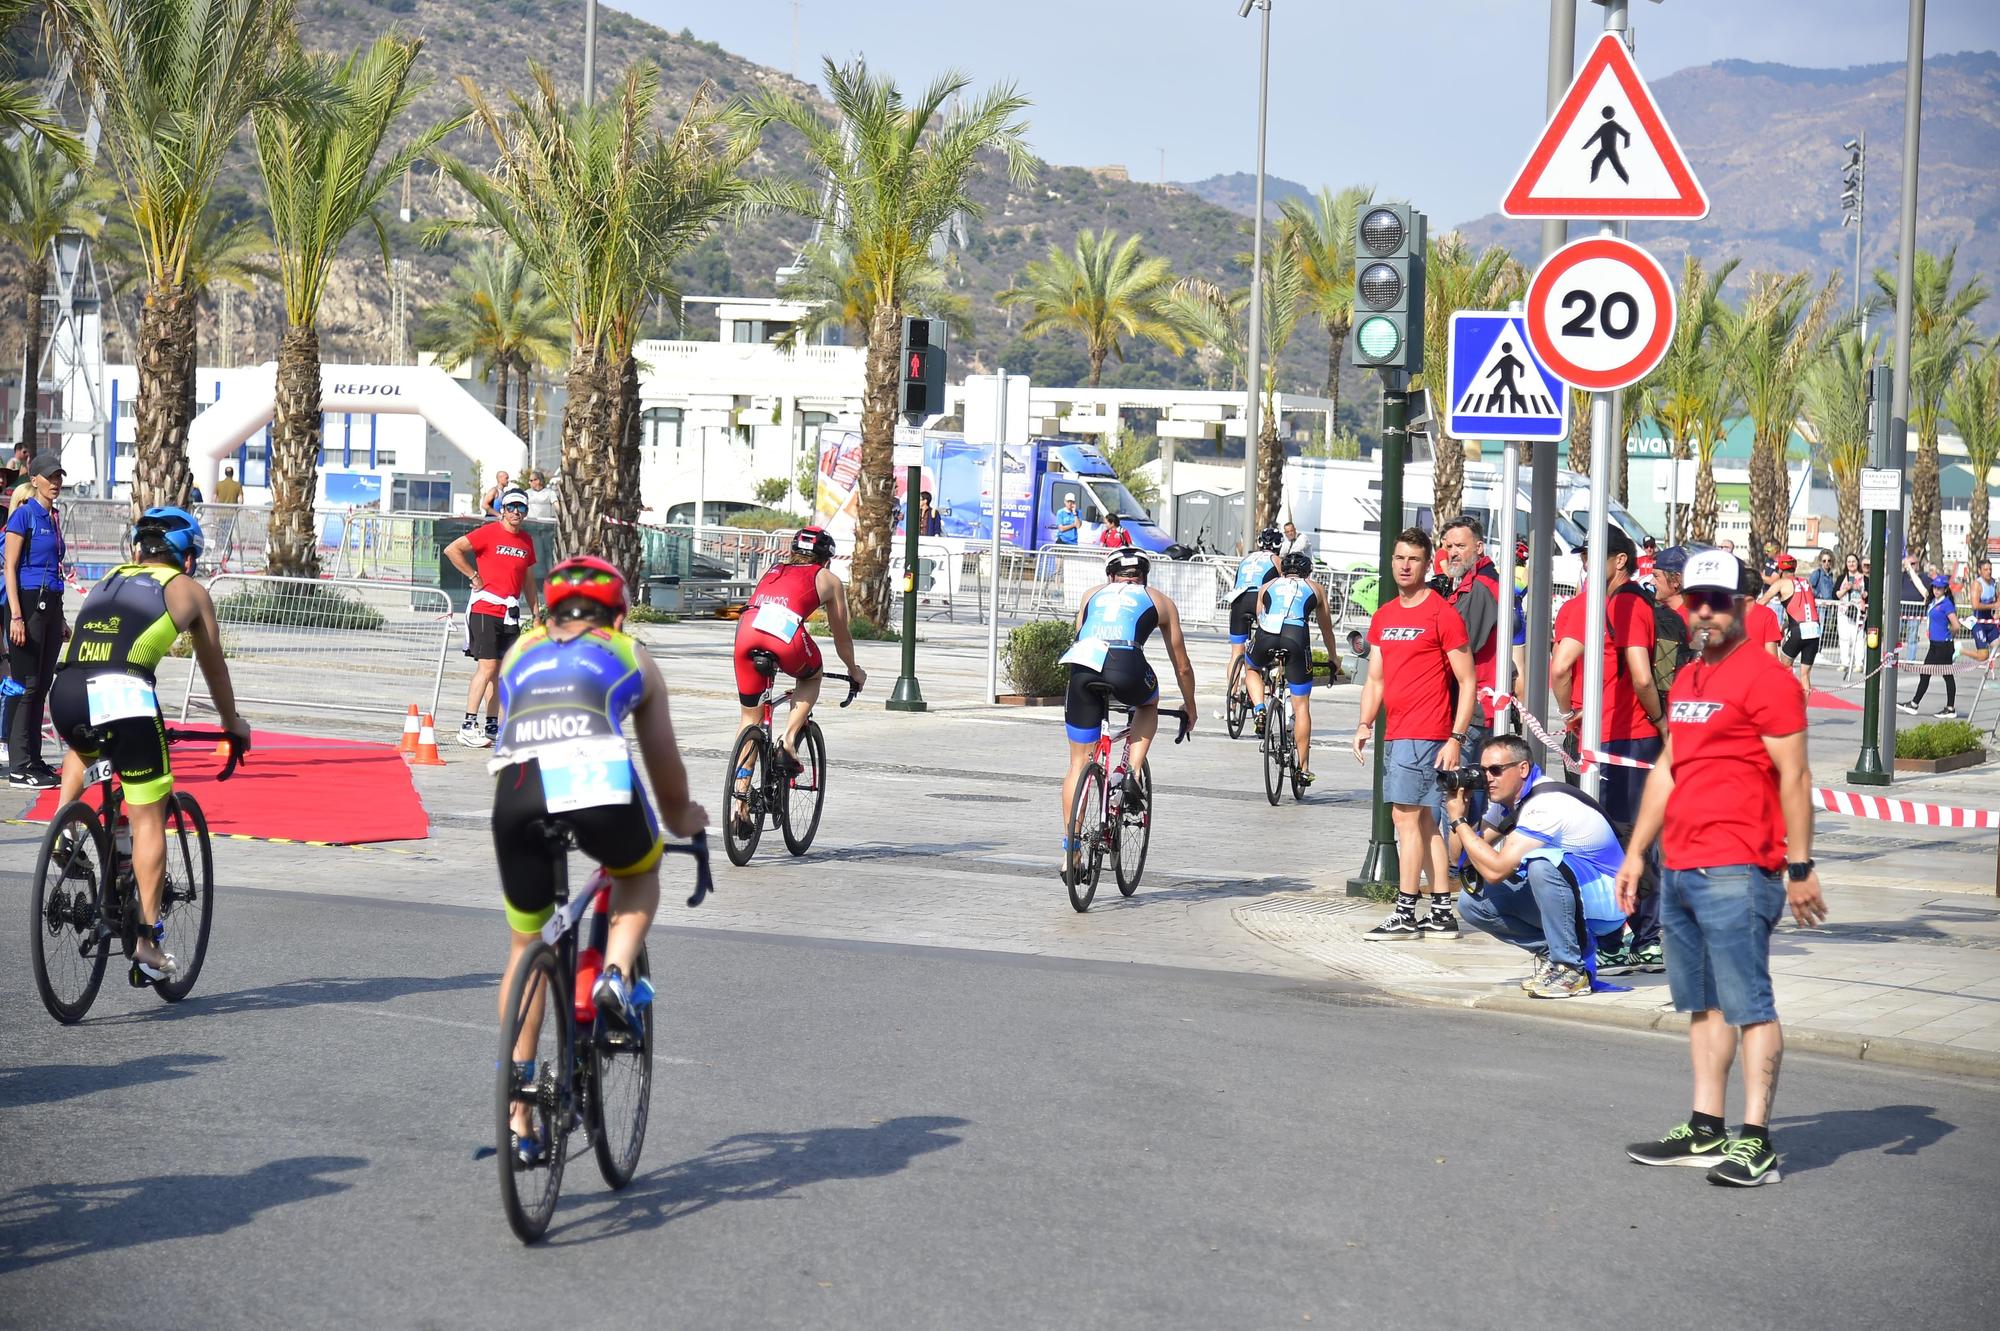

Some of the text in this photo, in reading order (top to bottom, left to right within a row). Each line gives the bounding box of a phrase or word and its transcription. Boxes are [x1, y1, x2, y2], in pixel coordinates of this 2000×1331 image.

[1561, 289, 1639, 340] 20
[334, 383, 402, 396] REPSOL
[1626, 437, 1699, 453] avana
[78, 641, 112, 661] CHANI
[515, 714, 592, 742] MUÑOZ
[89, 764, 111, 782] 116
